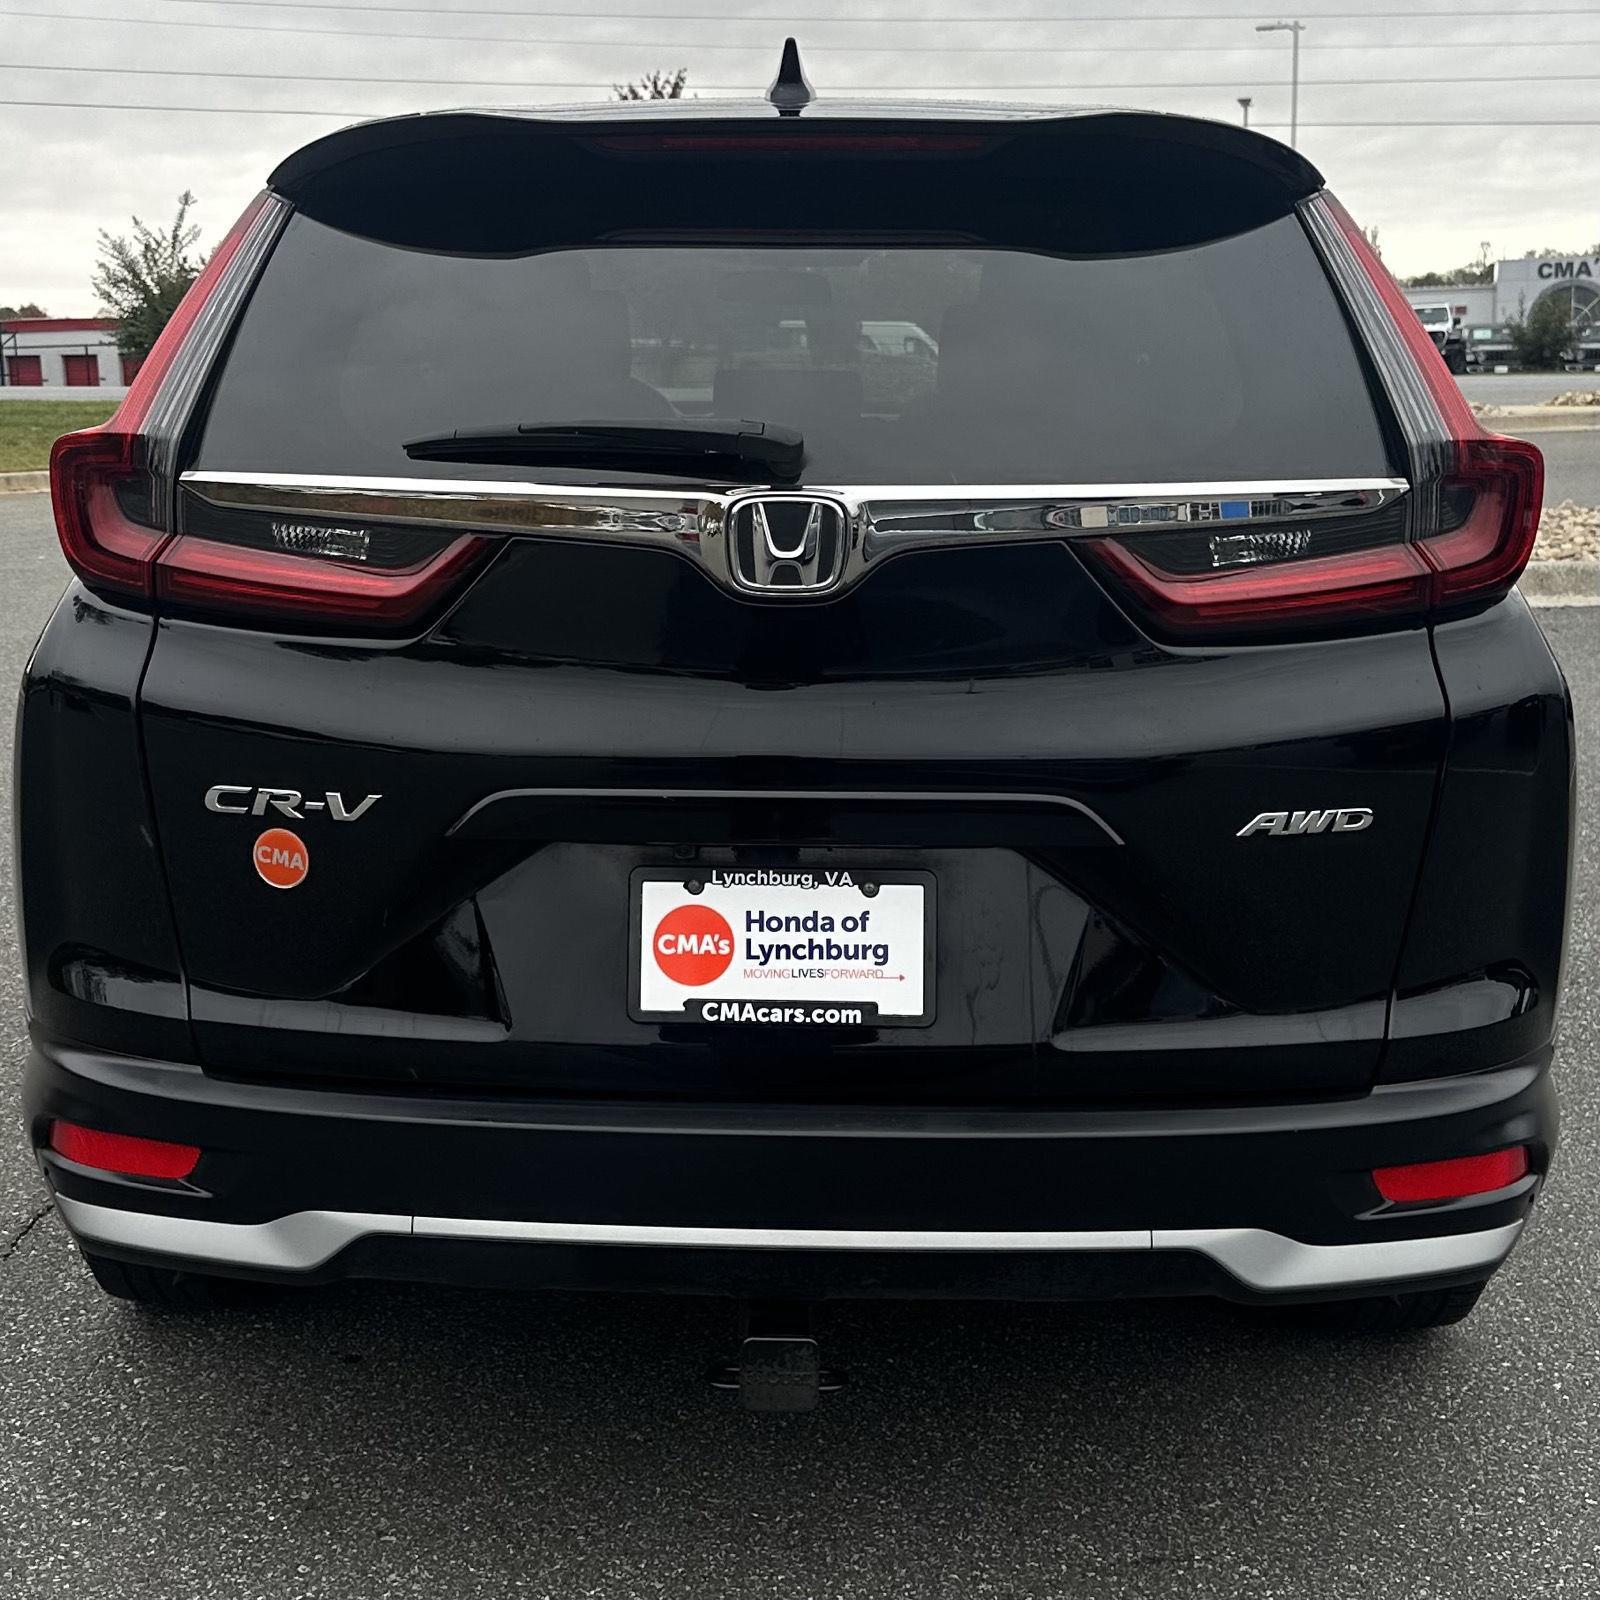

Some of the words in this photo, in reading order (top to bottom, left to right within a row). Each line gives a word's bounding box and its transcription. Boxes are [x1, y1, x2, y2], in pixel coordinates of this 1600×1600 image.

[204, 785, 383, 822] CR-V
[1235, 807, 1375, 837] AWD
[257, 845, 305, 871] CMA
[711, 869, 819, 889] Lynchburg,
[825, 871, 854, 887] VA
[745, 910, 835, 933] Honda
[841, 910, 870, 932] of
[657, 933, 731, 956] CMA's
[745, 938, 889, 967] Lynchburg
[701, 1002, 862, 1025] CMAcars.com
